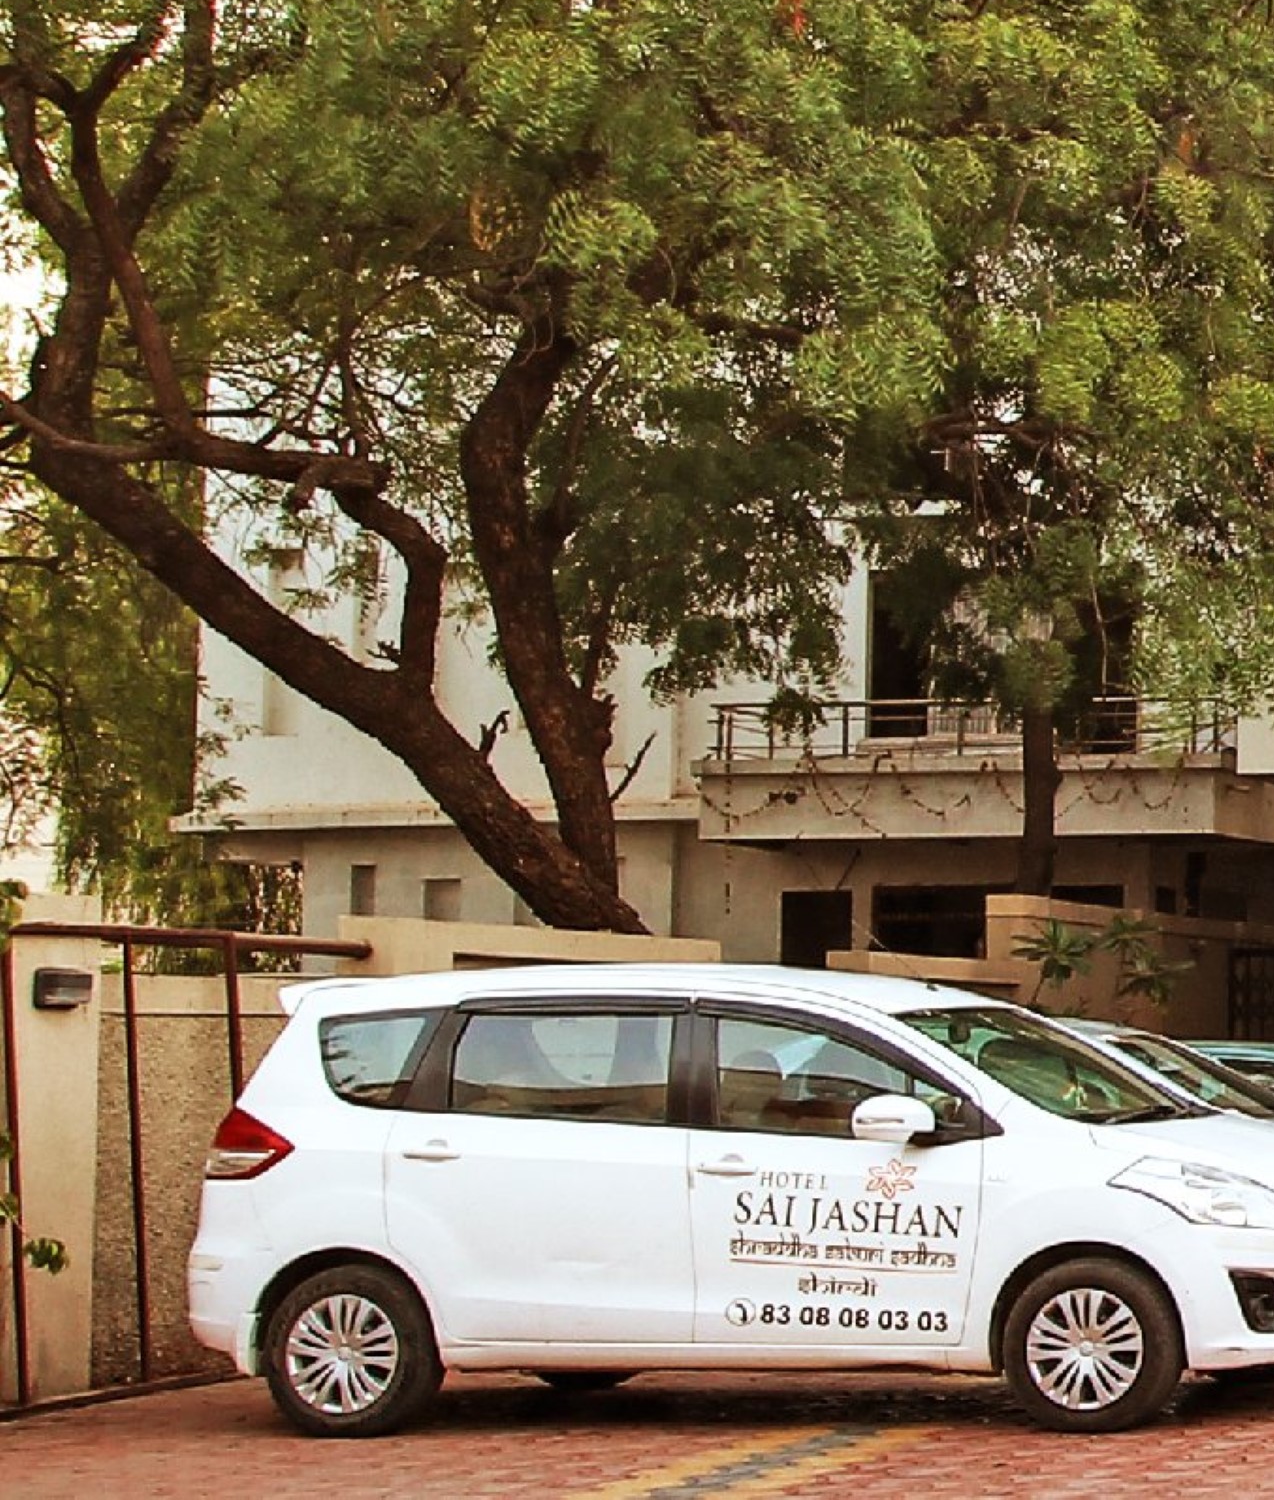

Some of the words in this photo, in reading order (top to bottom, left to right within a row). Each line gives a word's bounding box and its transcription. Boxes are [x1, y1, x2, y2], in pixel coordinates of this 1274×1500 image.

[760, 1171, 828, 1190] HOTEL
[734, 1190, 797, 1227] SAI
[807, 1198, 963, 1238] JASHAN
[760, 1304, 790, 1325] 83
[799, 1306, 830, 1326] 08
[838, 1308, 869, 1328] 08
[878, 1310, 909, 1331] 03
[917, 1311, 948, 1332] 03
